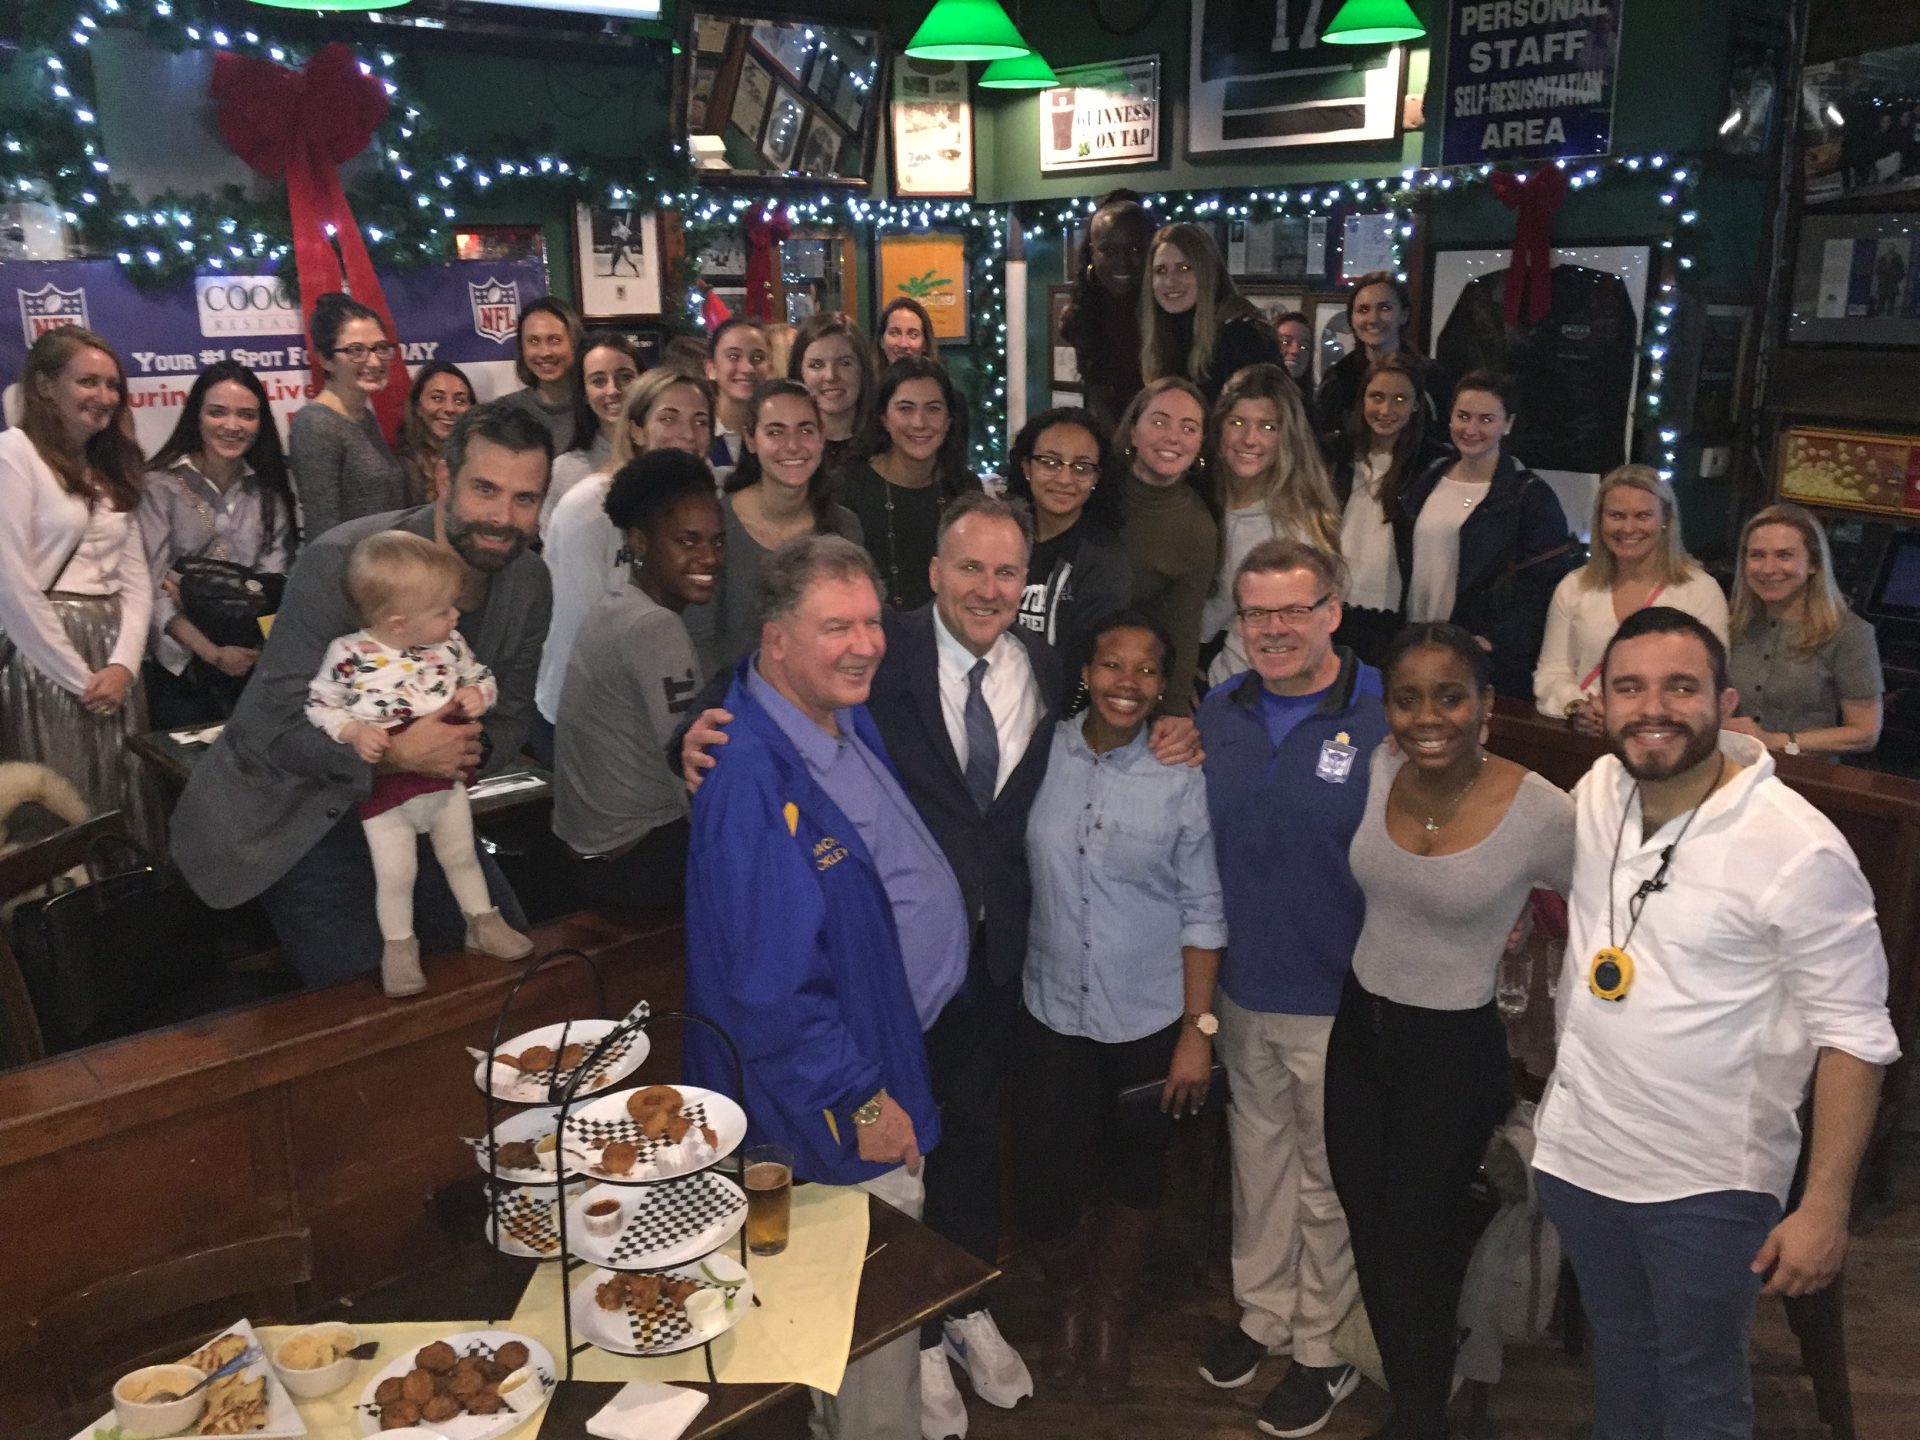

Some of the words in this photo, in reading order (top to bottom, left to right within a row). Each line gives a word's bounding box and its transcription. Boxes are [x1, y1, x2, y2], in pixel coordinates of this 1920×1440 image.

[1460, 0, 1608, 35] PERSONAL
[1468, 29, 1588, 73] STAFF
[1096, 132, 1116, 149] ON
[1120, 128, 1150, 147] TAP
[1481, 117, 1566, 150] AREA
[214, 319, 295, 330] RESTAU
[480, 306, 516, 333] NFL
[127, 383, 189, 408] urin
